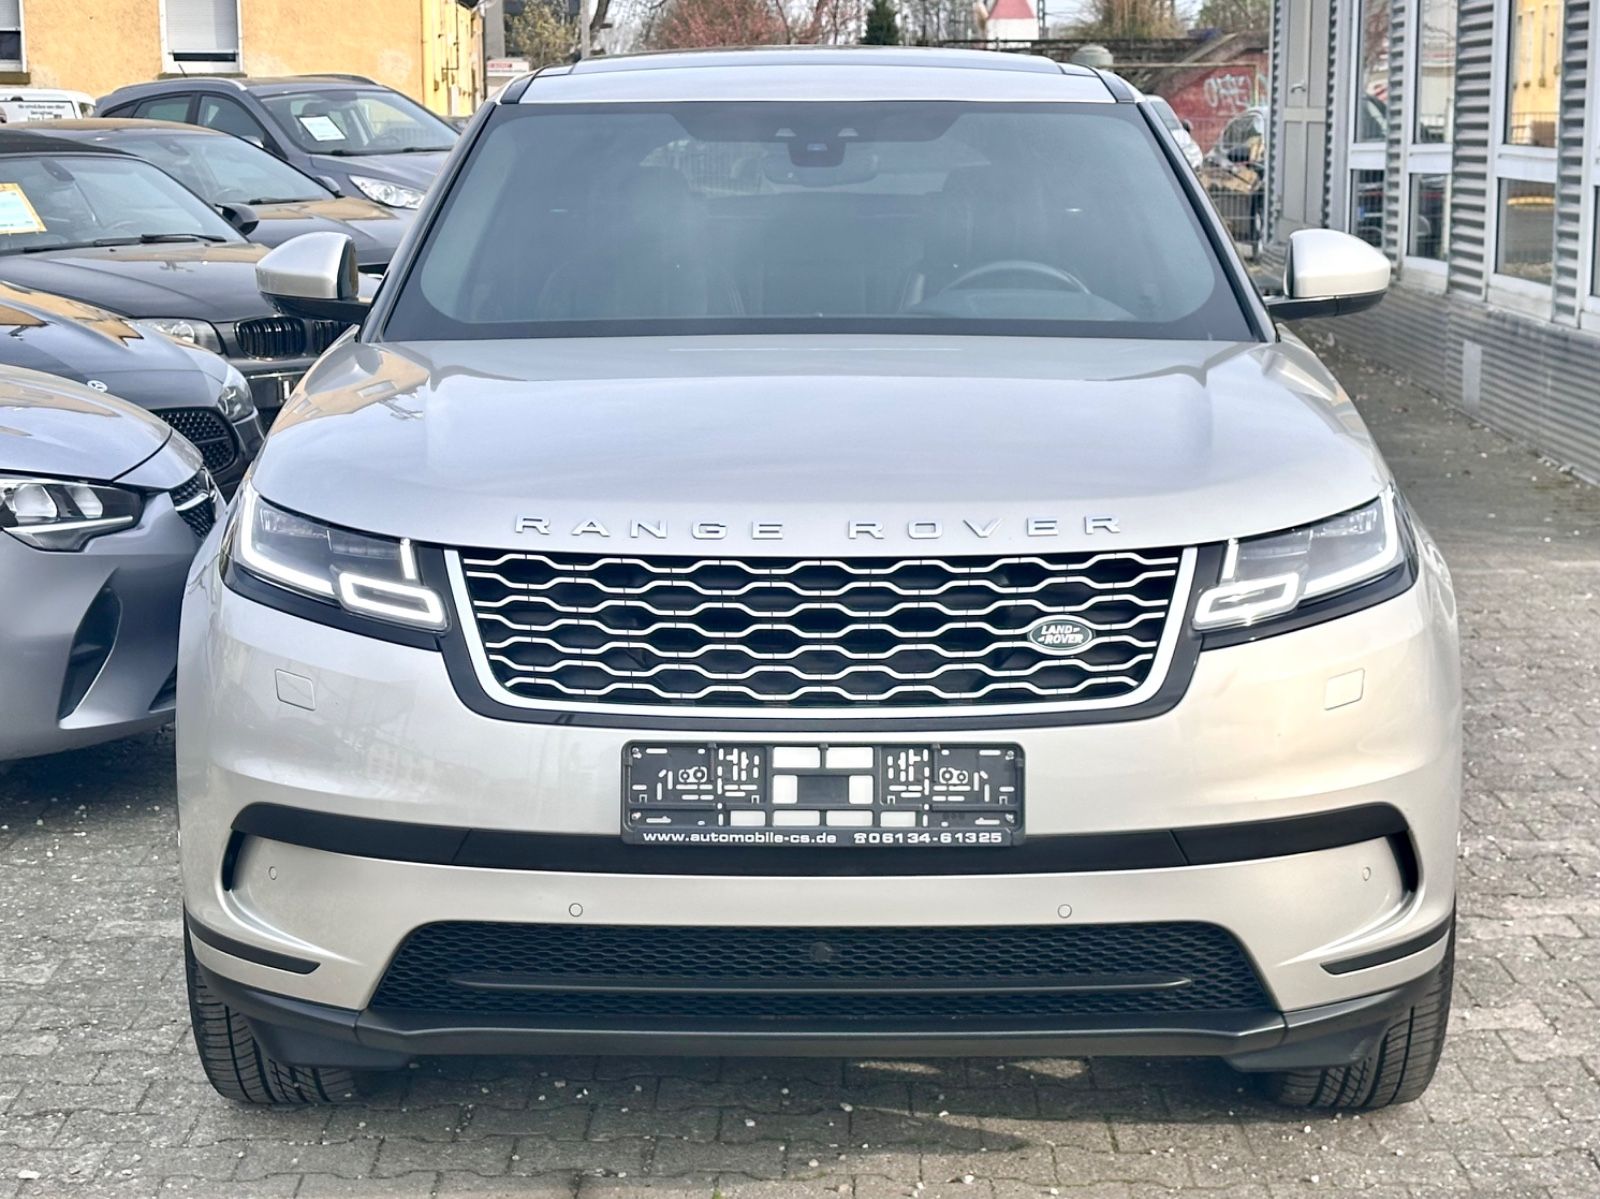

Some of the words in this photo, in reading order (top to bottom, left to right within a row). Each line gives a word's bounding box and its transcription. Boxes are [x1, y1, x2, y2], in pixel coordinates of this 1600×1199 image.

[514, 514, 784, 541] RANGE
[847, 515, 1122, 540] ROVER
[642, 831, 837, 844] www.automobile-cs.de
[868, 831, 1003, 844] 06134-61325
